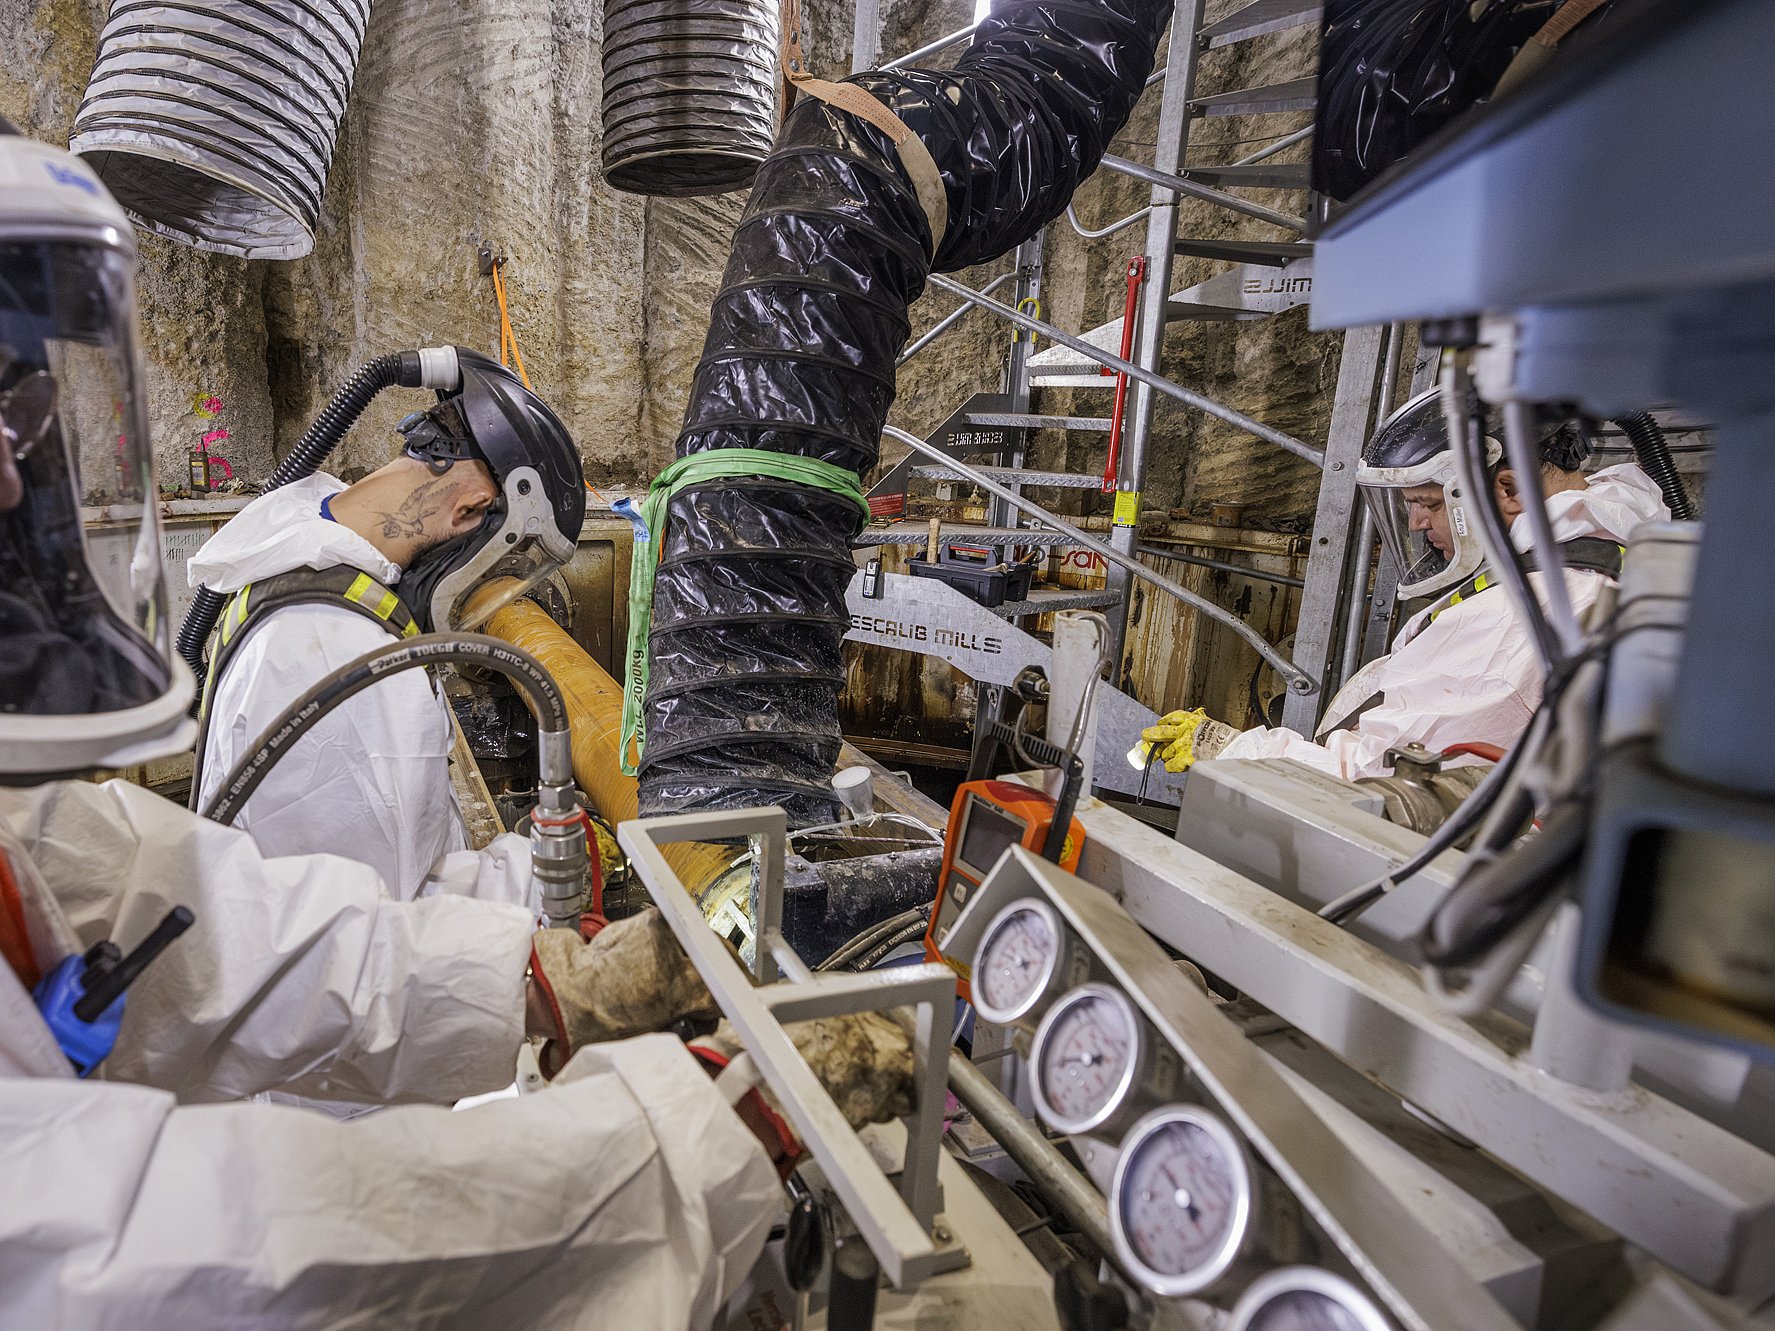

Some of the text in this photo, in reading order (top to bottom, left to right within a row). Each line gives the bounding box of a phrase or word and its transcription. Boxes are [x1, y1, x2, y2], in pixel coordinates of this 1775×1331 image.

[458, 642, 490, 655] COVER
[269, 725, 293, 748] Made
[299, 700, 320, 719] Italy
